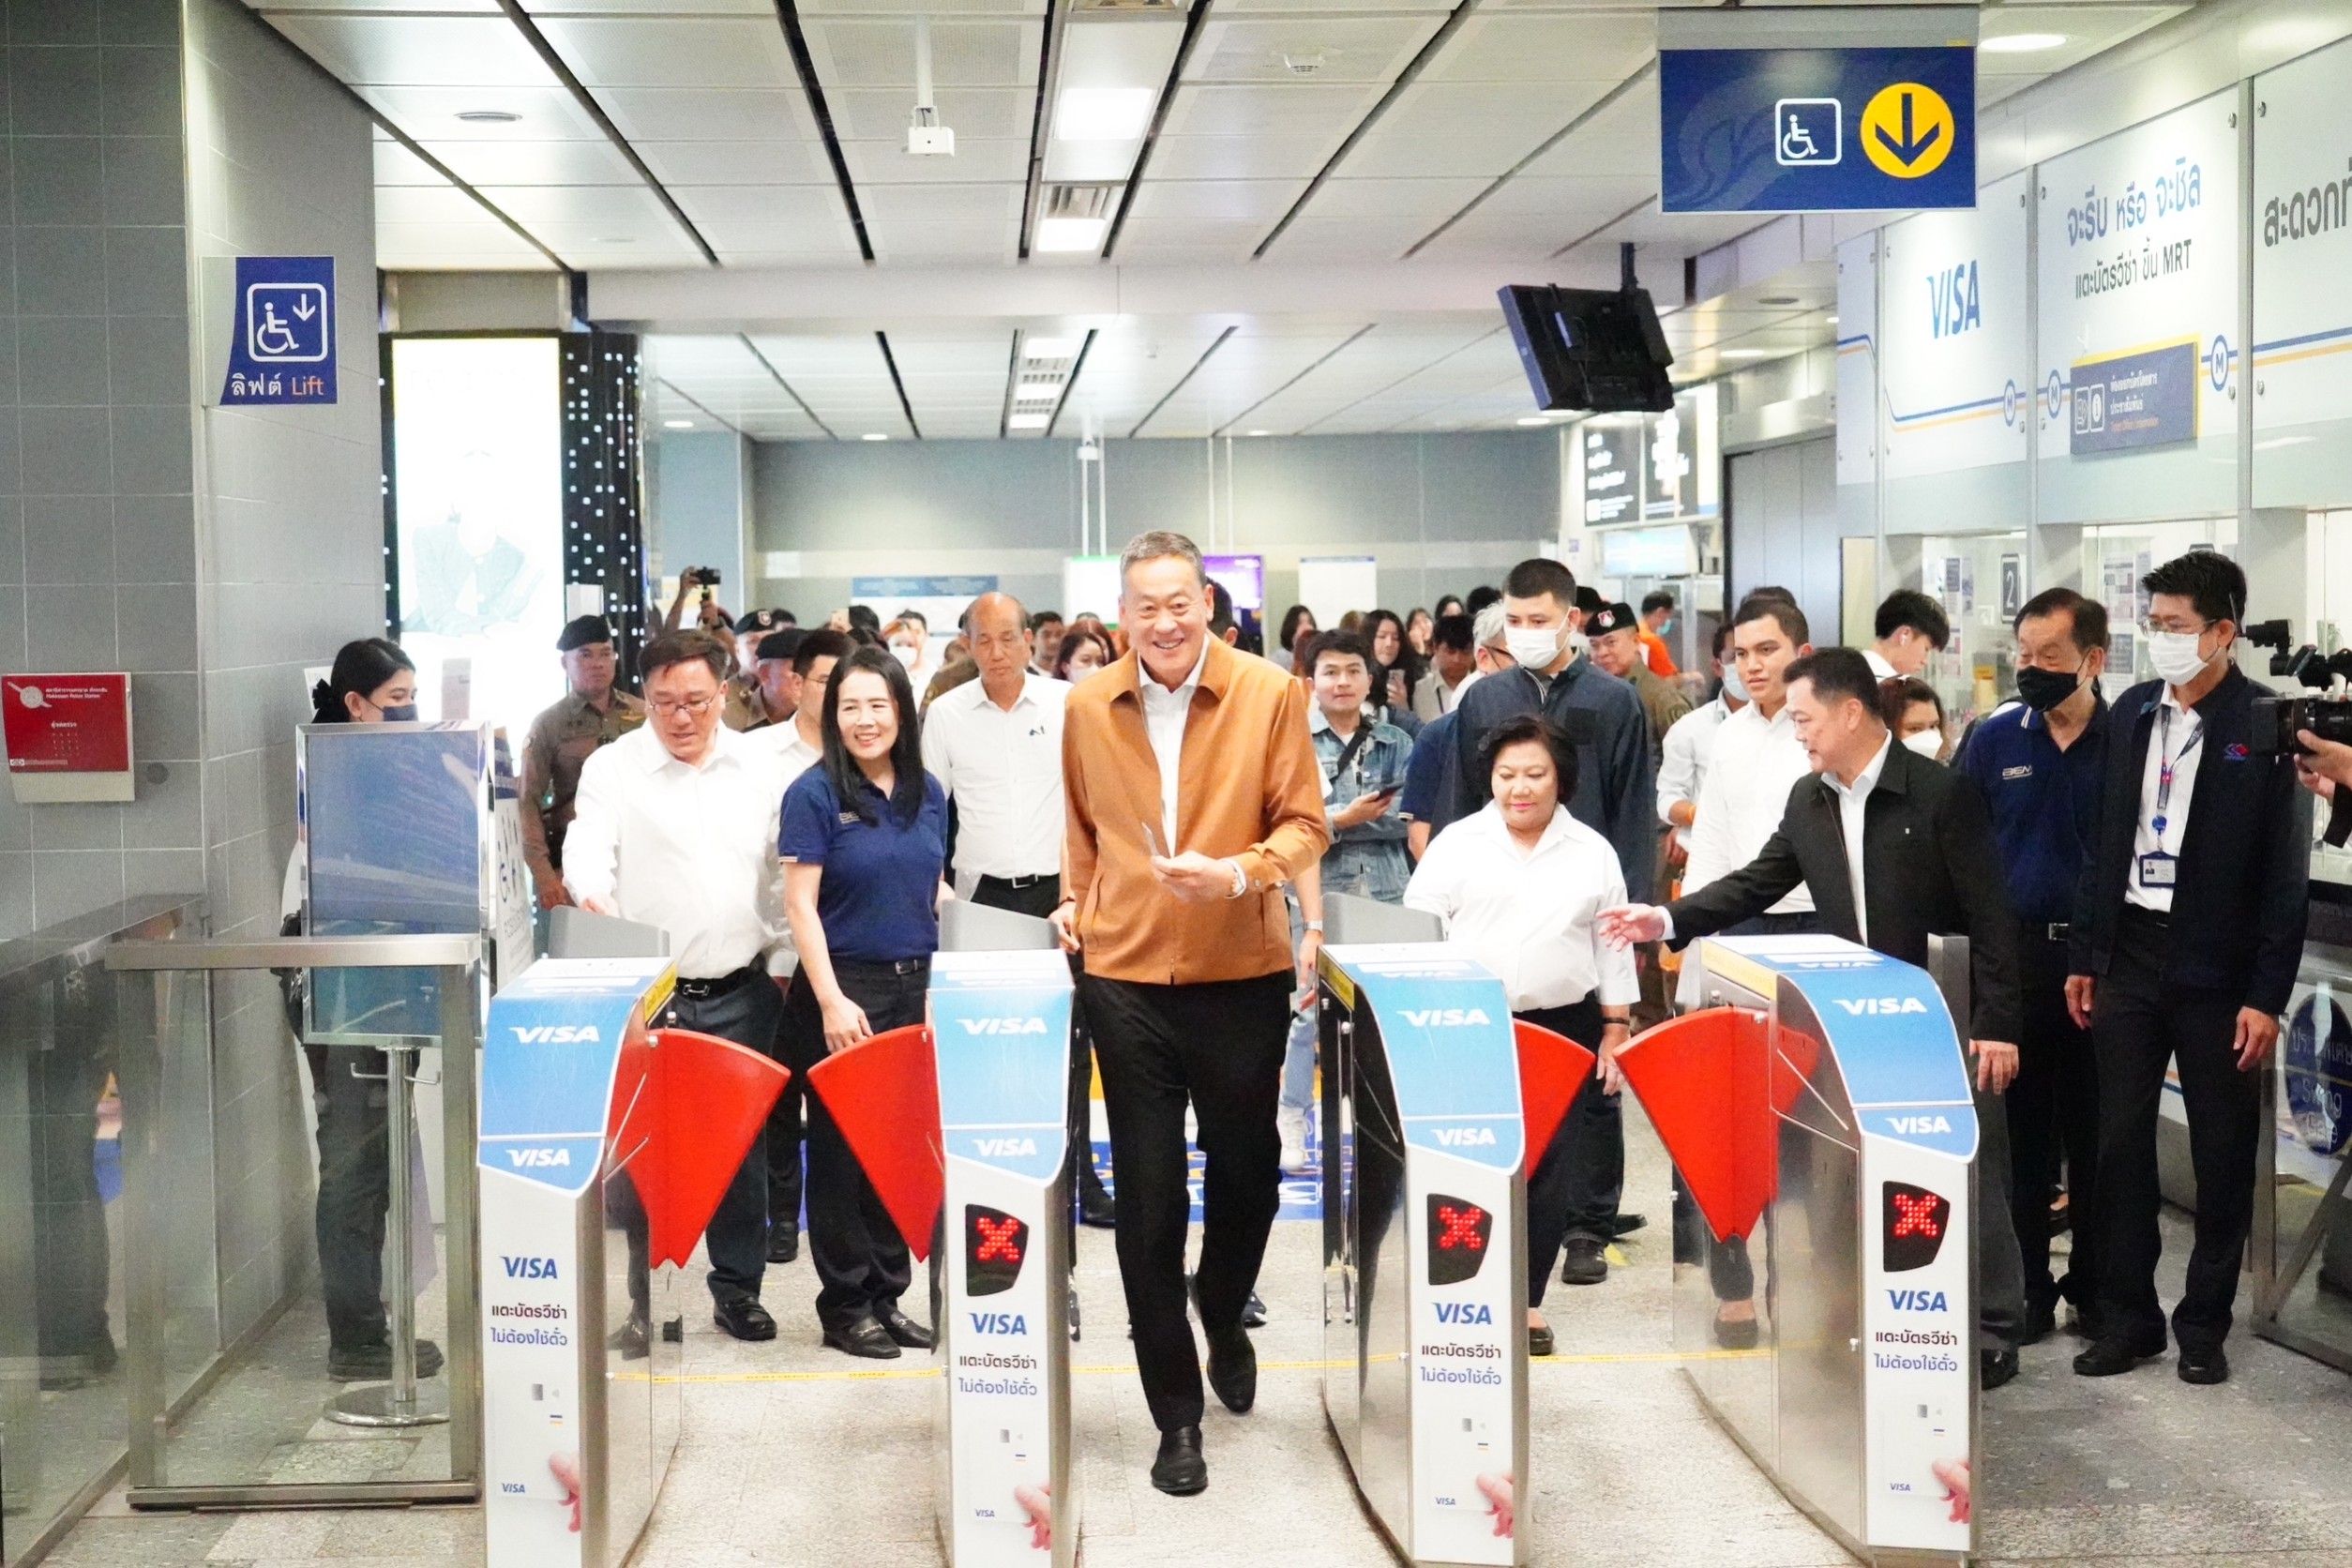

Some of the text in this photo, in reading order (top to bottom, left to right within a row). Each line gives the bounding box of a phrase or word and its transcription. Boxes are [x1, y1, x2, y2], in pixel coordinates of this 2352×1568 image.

[2066, 156, 2202, 248] จะรีบ หรือ จะชิล
[2074, 250, 2138, 299] แตะบัตรวีซ่า
[2163, 238, 2194, 276] MRT
[1926, 260, 1982, 340] VISA
[231, 372, 324, 398] ลิฟต์ Lift
[2005, 568, 2015, 609] 2
[1832, 997, 1928, 1016] VISA
[957, 1017, 1048, 1036] VISA
[1397, 1008, 1491, 1028] VISA
[508, 1025, 601, 1045] VISA
[1886, 1116, 1952, 1135] VISA
[1431, 1127, 1497, 1148] VISA
[506, 1147, 571, 1168] VISA
[972, 1138, 1038, 1158] VISA
[500, 1256, 559, 1279] VISA
[1884, 1289, 1949, 1312] VISA
[490, 1302, 568, 1320] แตะบัตรวีซ่า
[1429, 1303, 1493, 1326] VISA
[968, 1312, 1028, 1336] VISA
[490, 1325, 568, 1347] ไม่ต้องใช้ตั๋ว
[1875, 1328, 1959, 1347] แตะบัตรวีซ่า
[958, 1351, 1038, 1370] แตะบัตรวีซ่า
[1421, 1341, 1502, 1360] แตะบัตรวีซ่า
[1874, 1351, 1959, 1373] ไม่ต้องใช้ตั๋ว
[1420, 1364, 1502, 1386] ไม่ต้องใช้ตั๋ว
[957, 1377, 1038, 1397] ไม่ต้องใช้ตั๋ว
[502, 1483, 526, 1495] VISA
[1890, 1482, 1912, 1493] VISA
[1436, 1497, 1456, 1507] VISA
[975, 1508, 996, 1518] VISA
